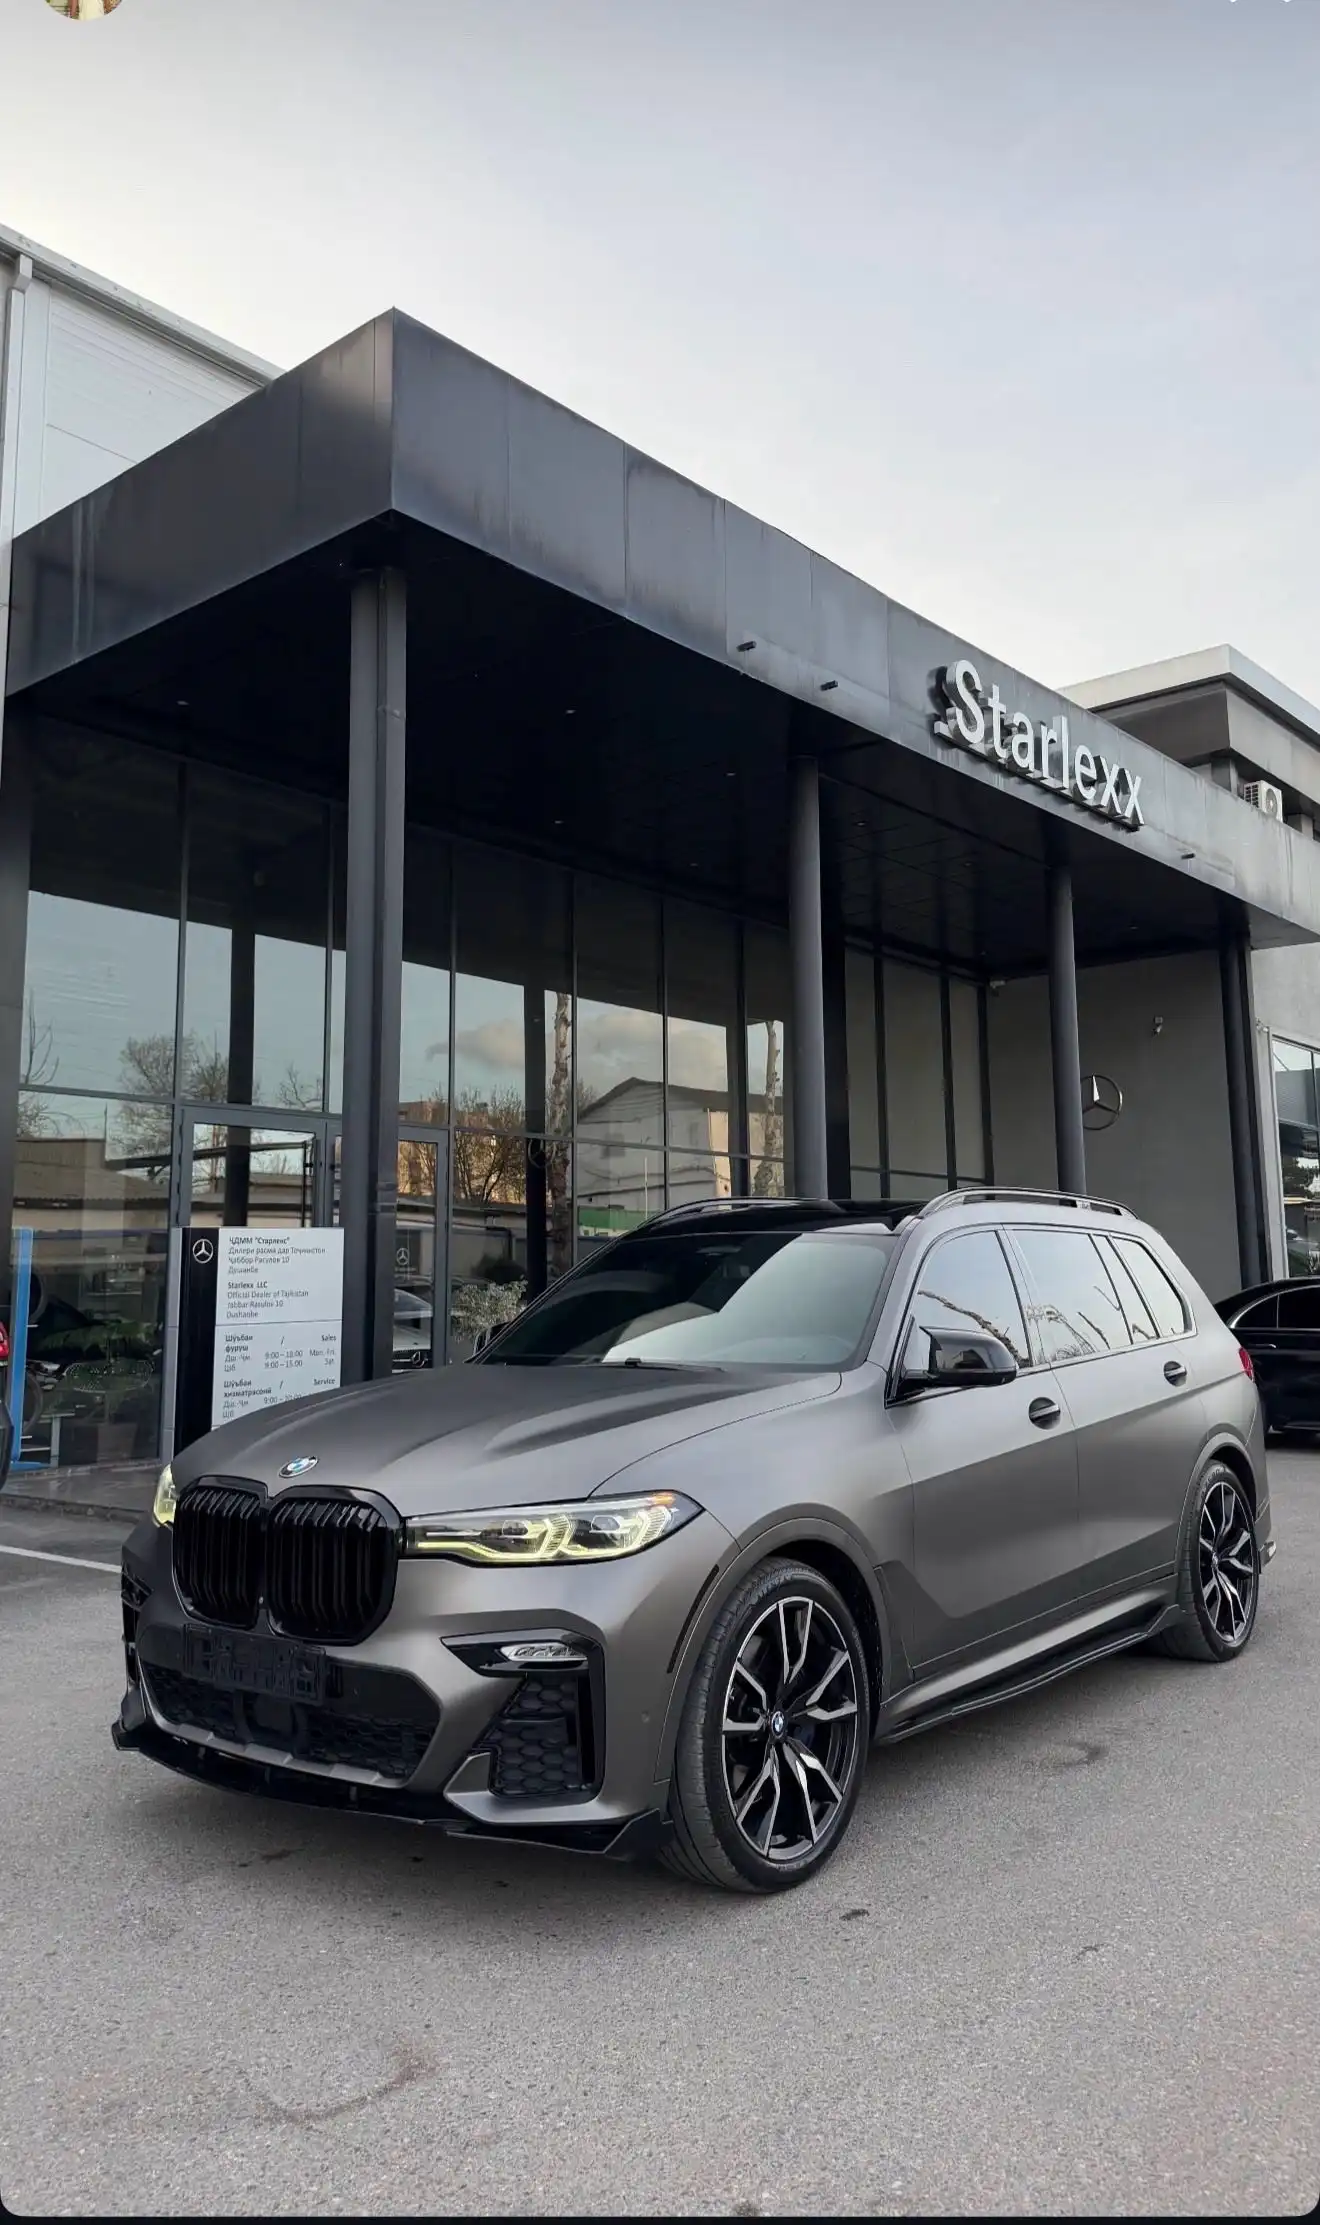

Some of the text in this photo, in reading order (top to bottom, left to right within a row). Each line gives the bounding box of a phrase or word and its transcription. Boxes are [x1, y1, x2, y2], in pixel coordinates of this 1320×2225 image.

[944, 659, 1145, 826] Starlexx
[282, 1255, 290, 1264] 10
[227, 1280, 268, 1289] Starlexx LLC
[227, 1290, 250, 1299] Official
[251, 1290, 271, 1299] Dealer
[273, 1289, 280, 1298] of
[321, 1334, 337, 1342] Sales
[313, 1378, 336, 1386] Service
